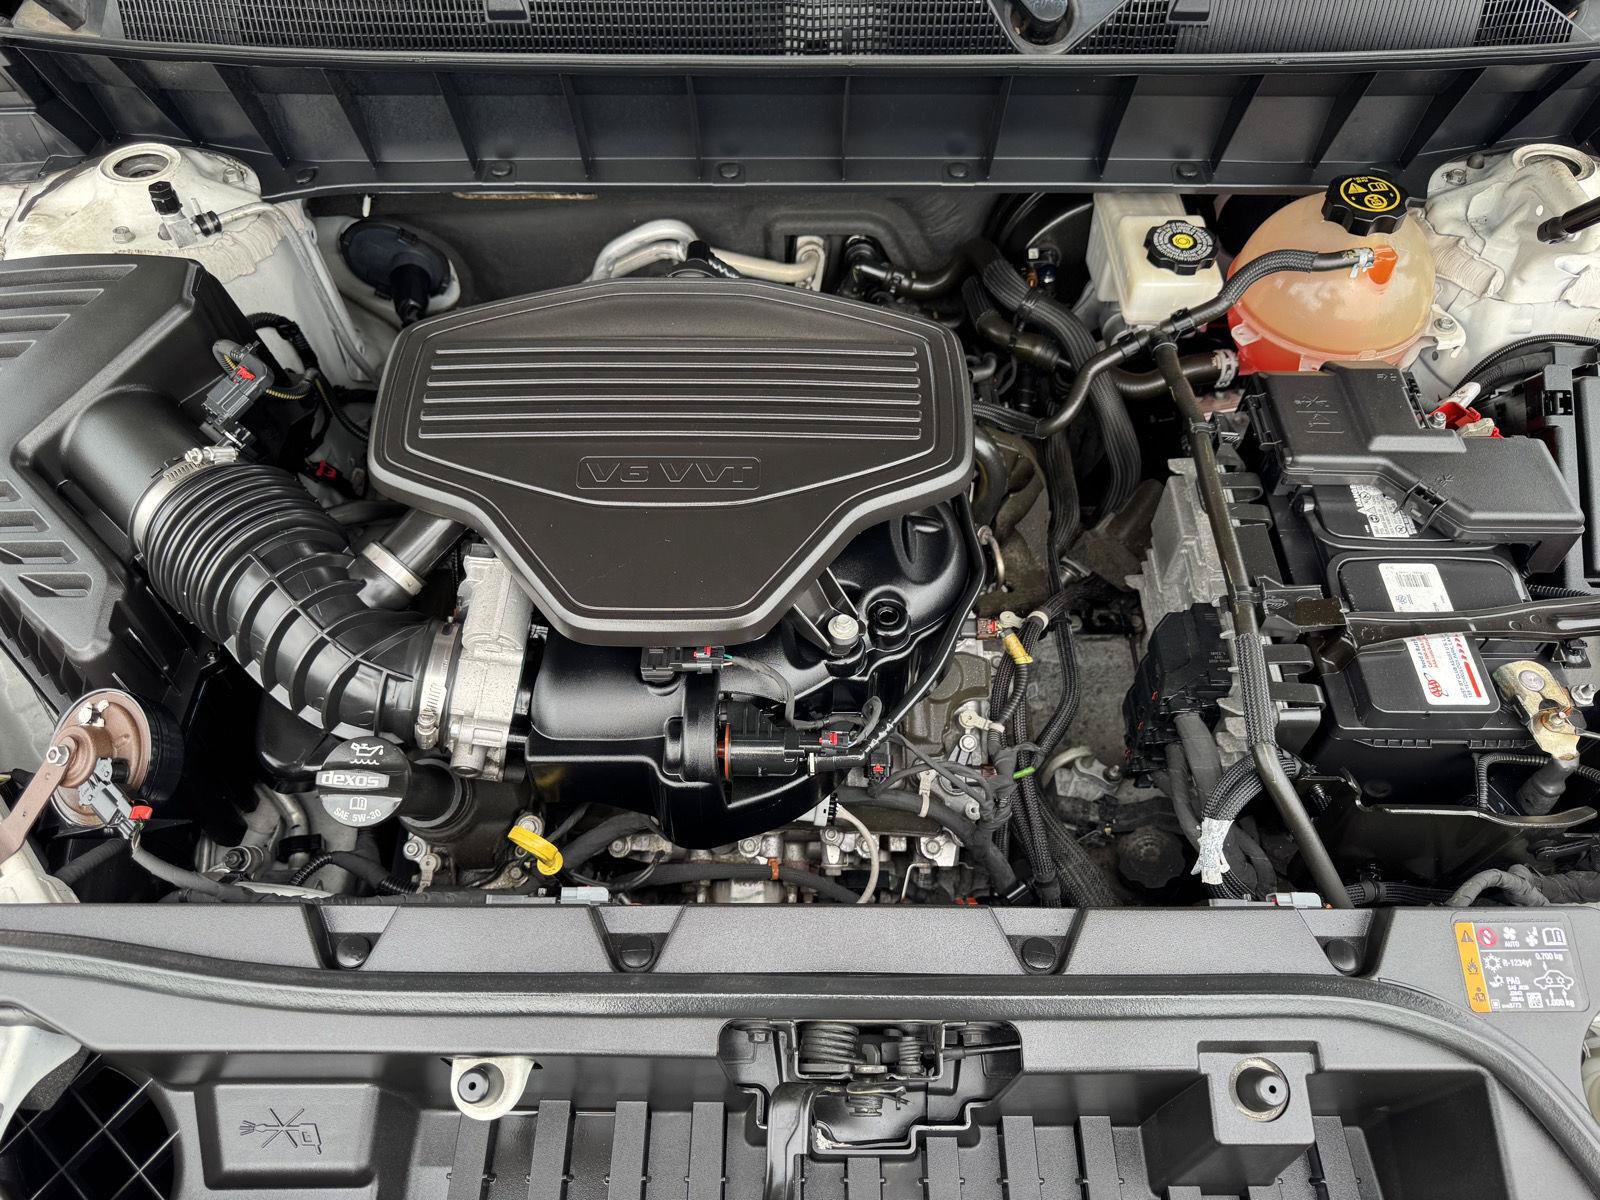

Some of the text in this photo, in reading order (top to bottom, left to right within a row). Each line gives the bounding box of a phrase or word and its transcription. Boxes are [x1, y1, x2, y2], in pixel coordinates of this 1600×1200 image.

[586, 462, 754, 483] V6 VVT
[322, 771, 380, 786] dexos
[333, 807, 382, 822] SAE 5W-30
[1554, 952, 1564, 961] kg
[1502, 958, 1532, 968] R-1234yf
[1506, 976, 1520, 984] PAG
[1564, 999, 1575, 1008] kg
